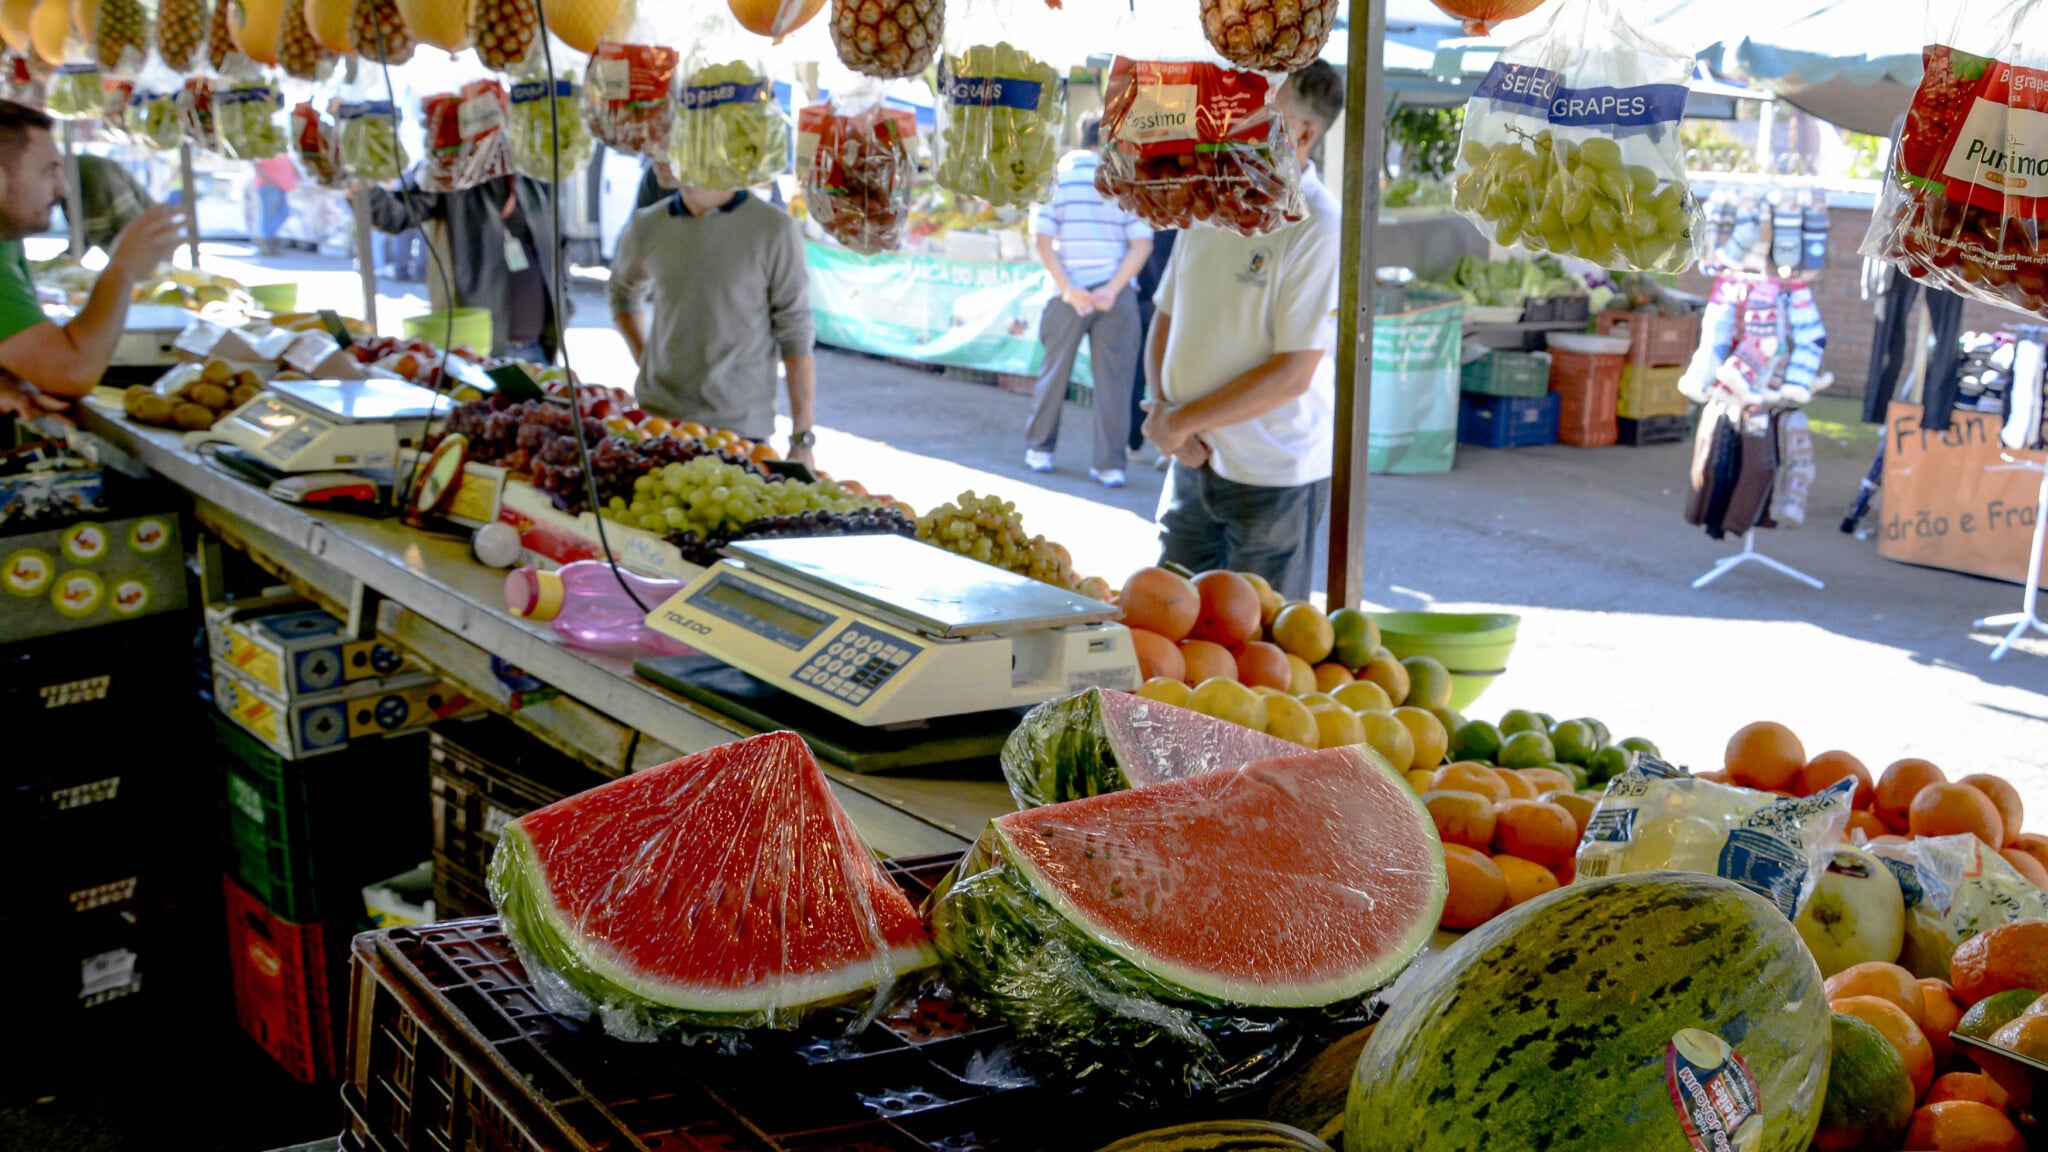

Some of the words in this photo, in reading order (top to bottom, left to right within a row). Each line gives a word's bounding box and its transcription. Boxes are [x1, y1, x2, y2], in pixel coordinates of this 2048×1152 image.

[1551, 96, 1646, 118] GRAPES
[1960, 513, 1976, 533] e
[1987, 501, 2040, 532] Fra
[663, 610, 713, 636] TOLEDO
[1678, 1066, 1722, 1131] JOAQUIM
